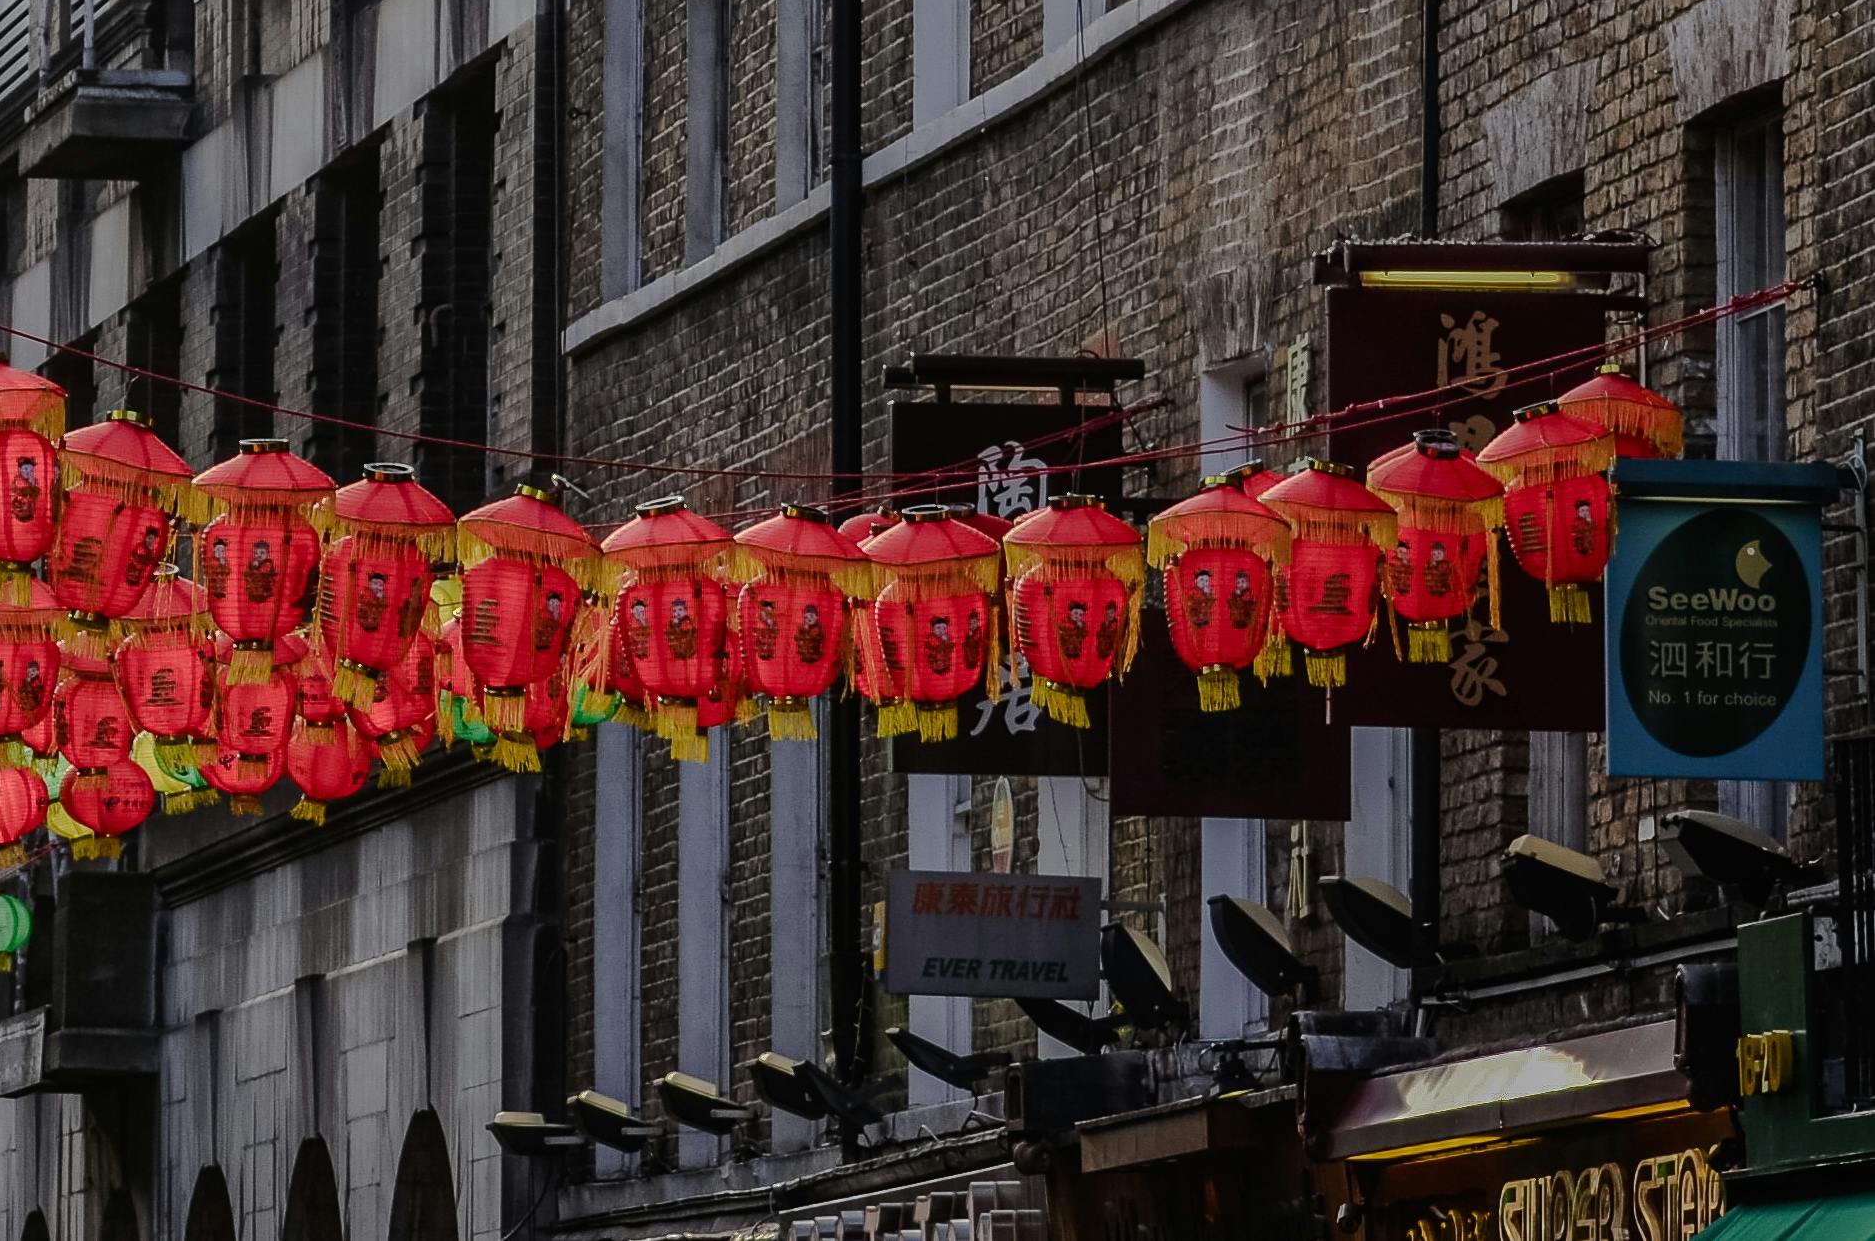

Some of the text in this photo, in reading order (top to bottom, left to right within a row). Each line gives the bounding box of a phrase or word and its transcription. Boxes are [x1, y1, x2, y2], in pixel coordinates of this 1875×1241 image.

[1647, 585, 1777, 613] SeeWoo
[1645, 614, 1779, 629] Oriental Food Specialists
[1648, 639, 1777, 680] 泗和行
[1647, 689, 1777, 708] No. 1 for choice
[921, 956, 1070, 984] EVER TRAVEL
